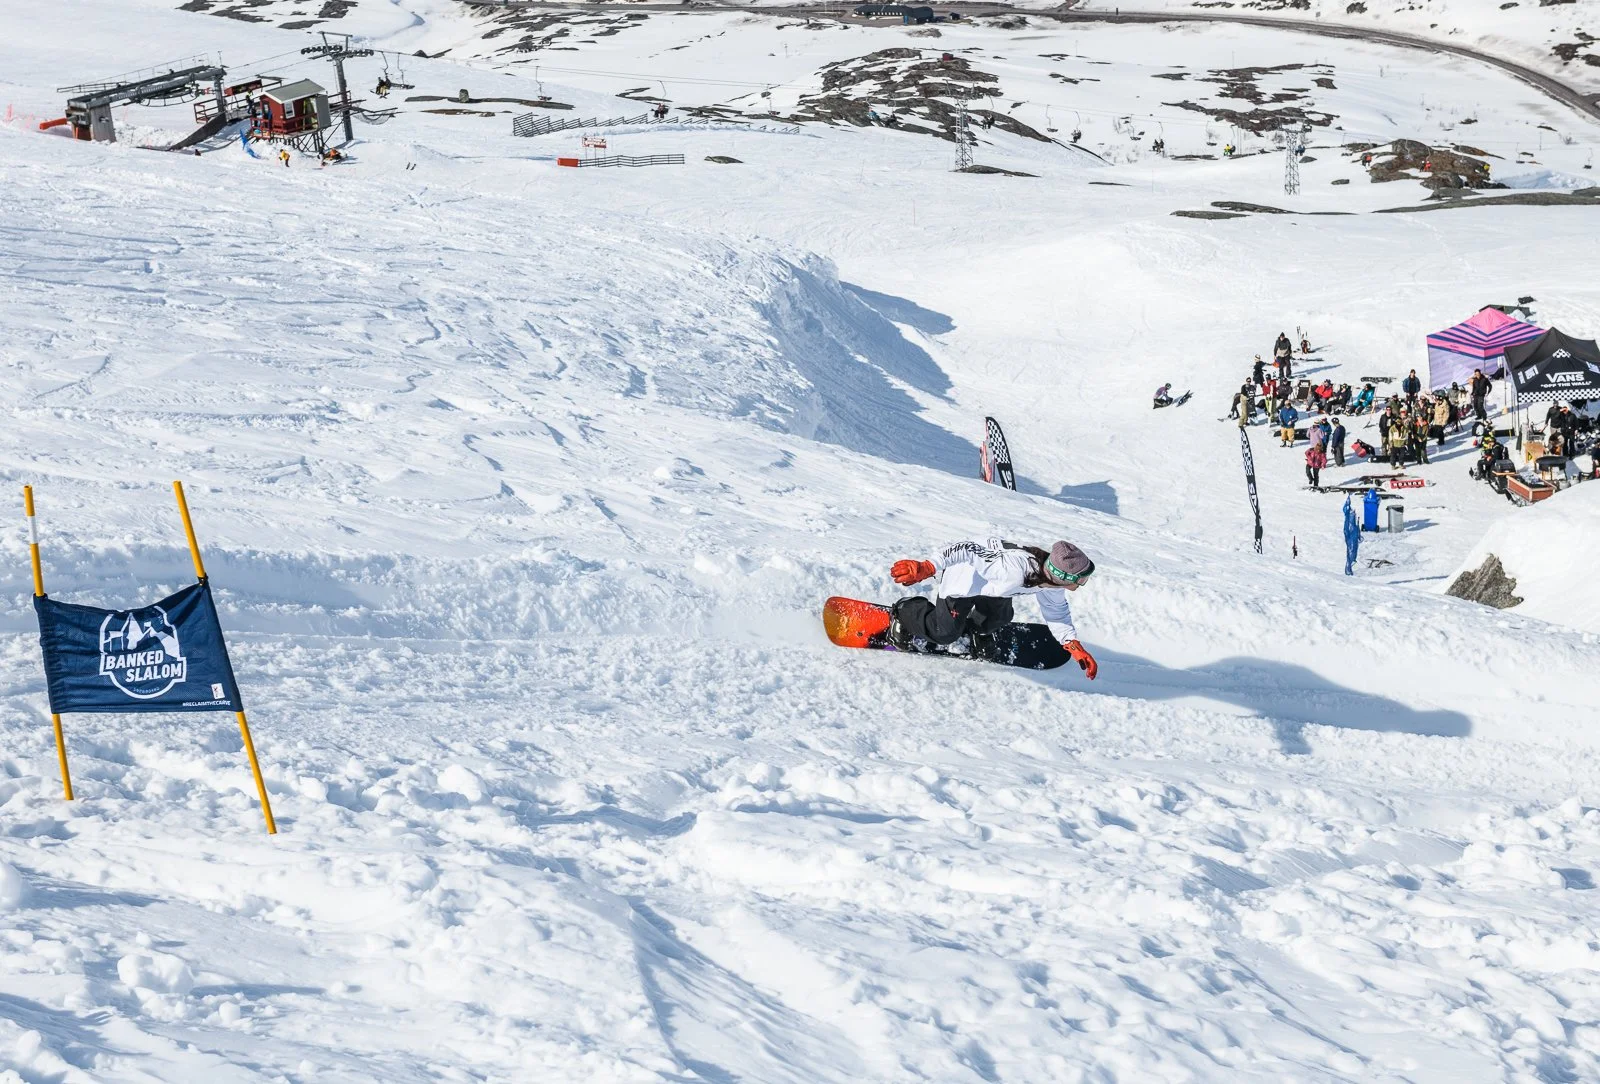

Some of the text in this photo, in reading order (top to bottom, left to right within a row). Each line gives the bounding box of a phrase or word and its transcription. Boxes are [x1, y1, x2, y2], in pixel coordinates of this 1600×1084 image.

[1546, 371, 1585, 383] VANS
[105, 650, 164, 670] BANKED
[125, 663, 182, 683] SLALOM
